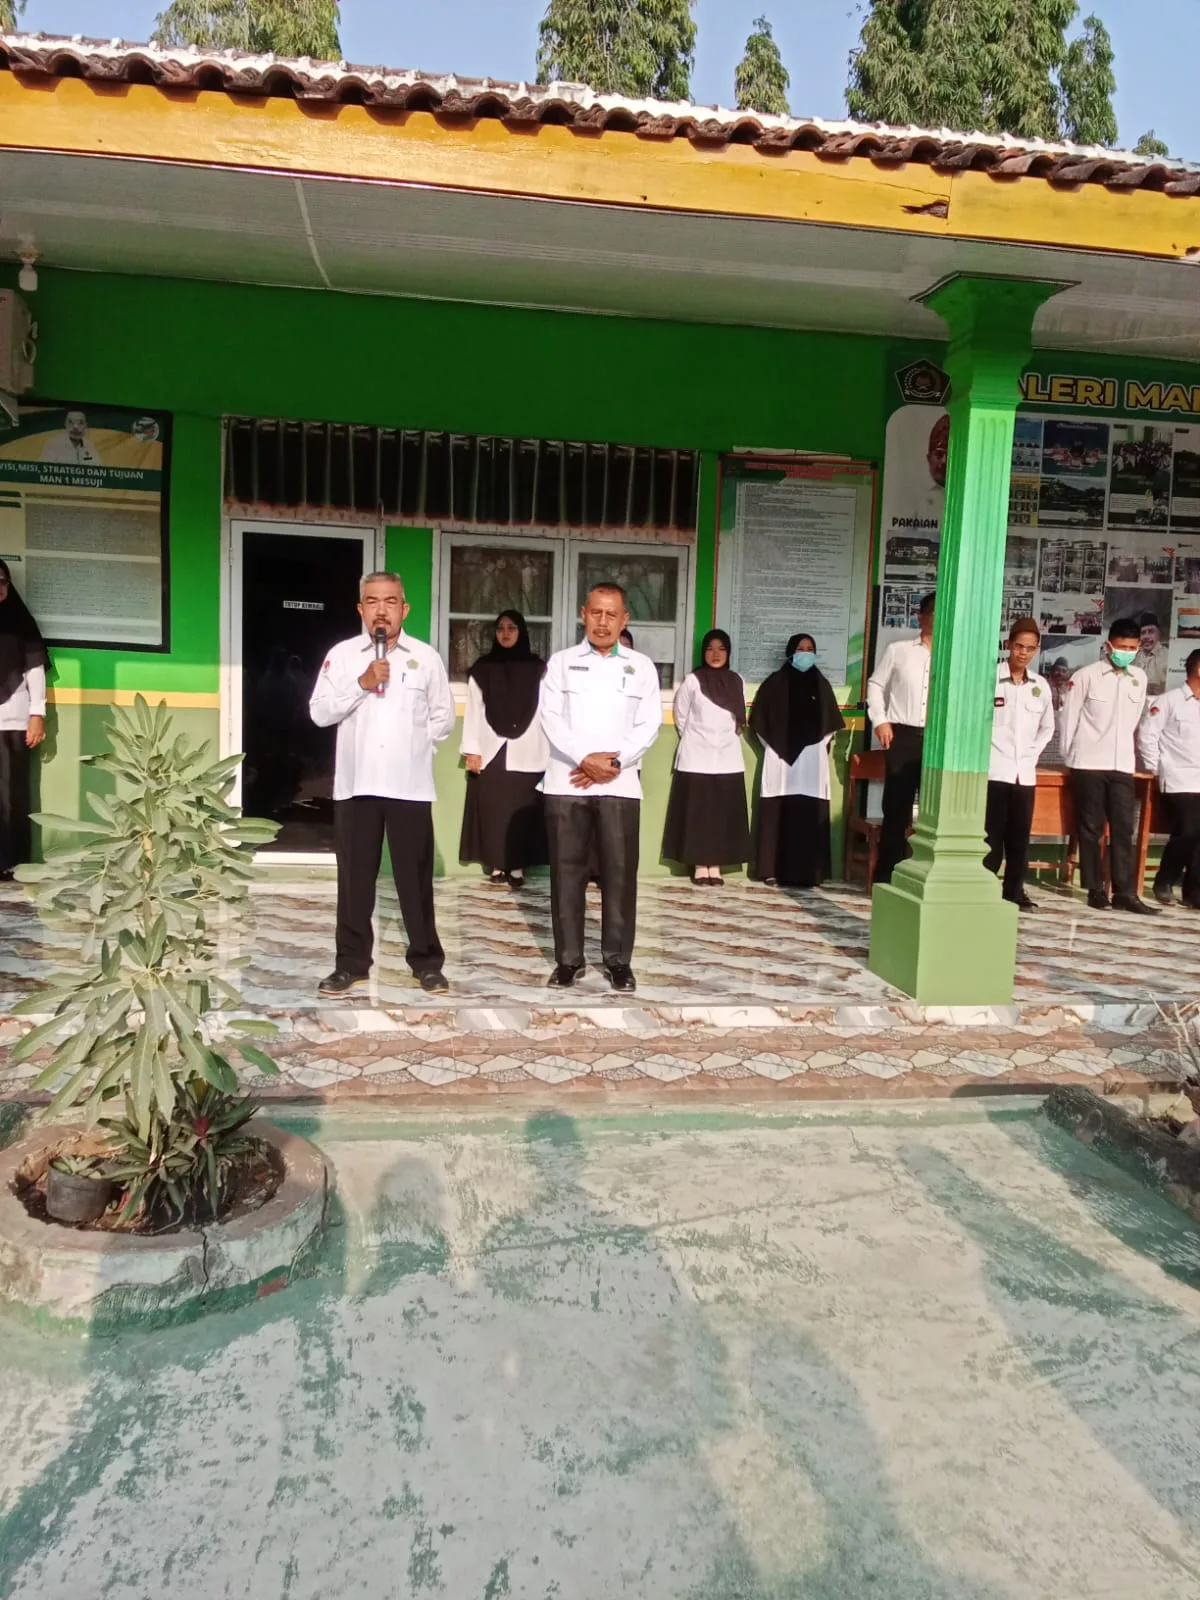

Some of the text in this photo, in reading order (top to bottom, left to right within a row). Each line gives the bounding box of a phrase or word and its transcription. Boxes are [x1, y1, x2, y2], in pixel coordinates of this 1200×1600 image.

[1017, 374, 1200, 413] LERI MA
[43, 465, 85, 475] STRATEGI
[87, 468, 107, 477] DAN
[109, 470, 144, 480] TUJUAN
[40, 475, 103, 488] MAN 1 MESUJI
[892, 517, 938, 529] PAKAIAN
